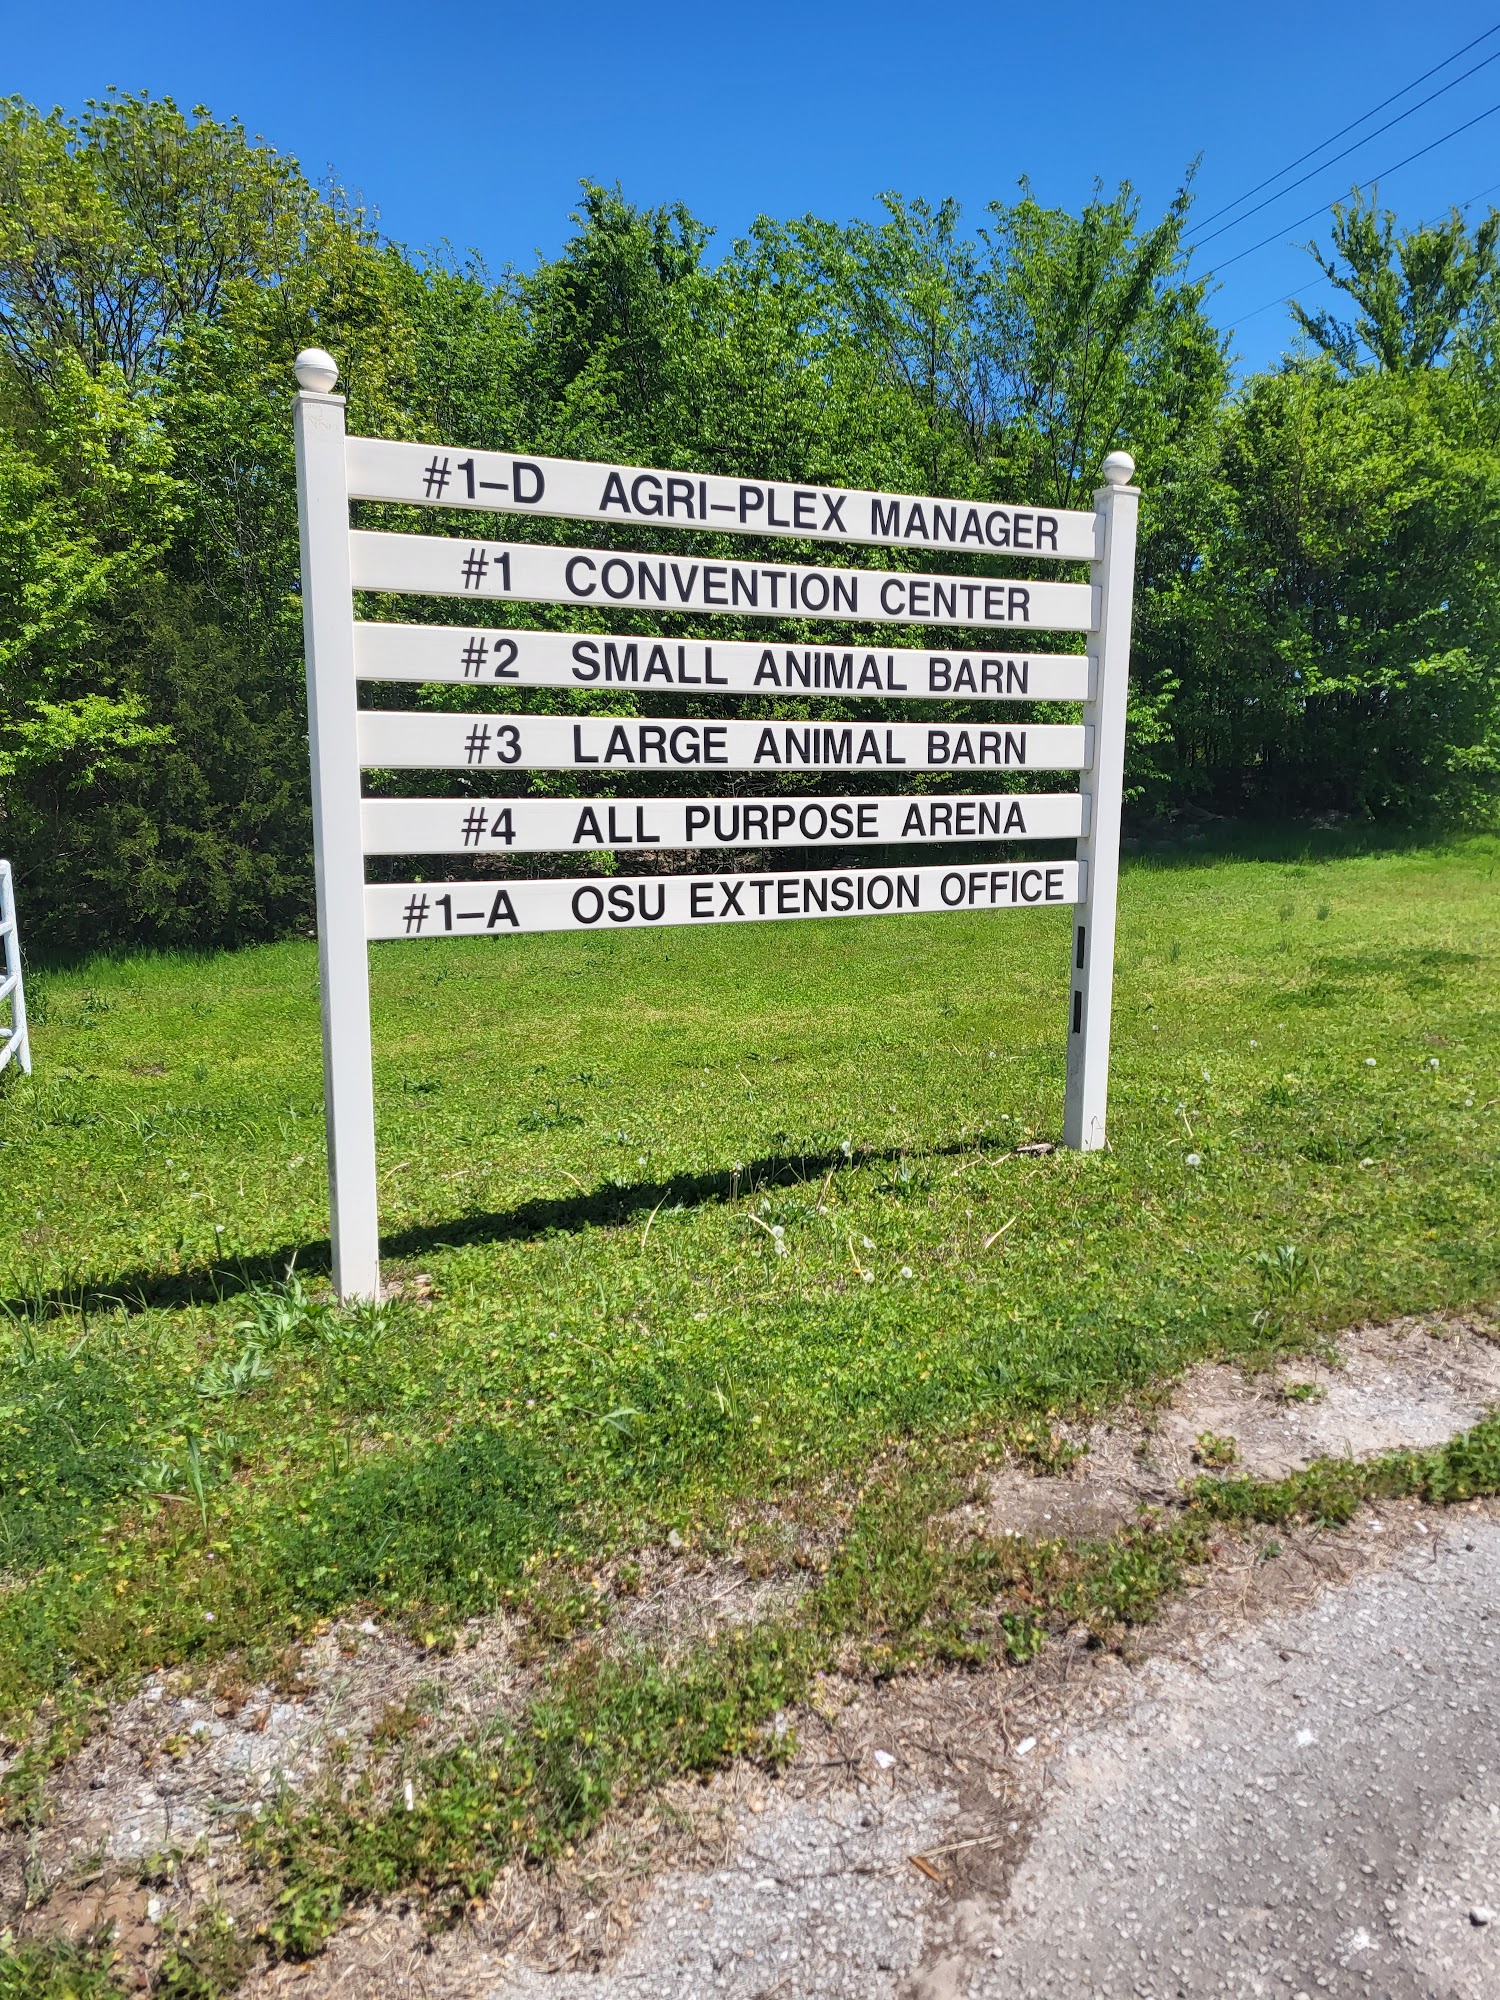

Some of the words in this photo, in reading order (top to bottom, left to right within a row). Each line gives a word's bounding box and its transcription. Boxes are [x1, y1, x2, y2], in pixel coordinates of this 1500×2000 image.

[871, 498, 1059, 551] MANAGER
[460, 547, 511, 592] #1
[565, 555, 858, 613] CONVENTION
[880, 578, 1030, 622] CENTER
[460, 636, 520, 678] #2
[571, 640, 729, 687] SMALL
[753, 649, 908, 691] ANIMAL
[928, 656, 1029, 694] BARN
[464, 723, 522, 765] #3
[573, 724, 729, 765] LARGE
[753, 727, 907, 765] ANIMAL
[927, 730, 1027, 765] BARN
[460, 806, 517, 847] #4
[572, 805, 661, 844] ALL
[685, 803, 879, 842] PURPOSE
[900, 801, 1027, 837] ARENA
[571, 884, 666, 925] OSU
[690, 874, 920, 919] EXTENSION
[940, 868, 1064, 907] OFFICE
